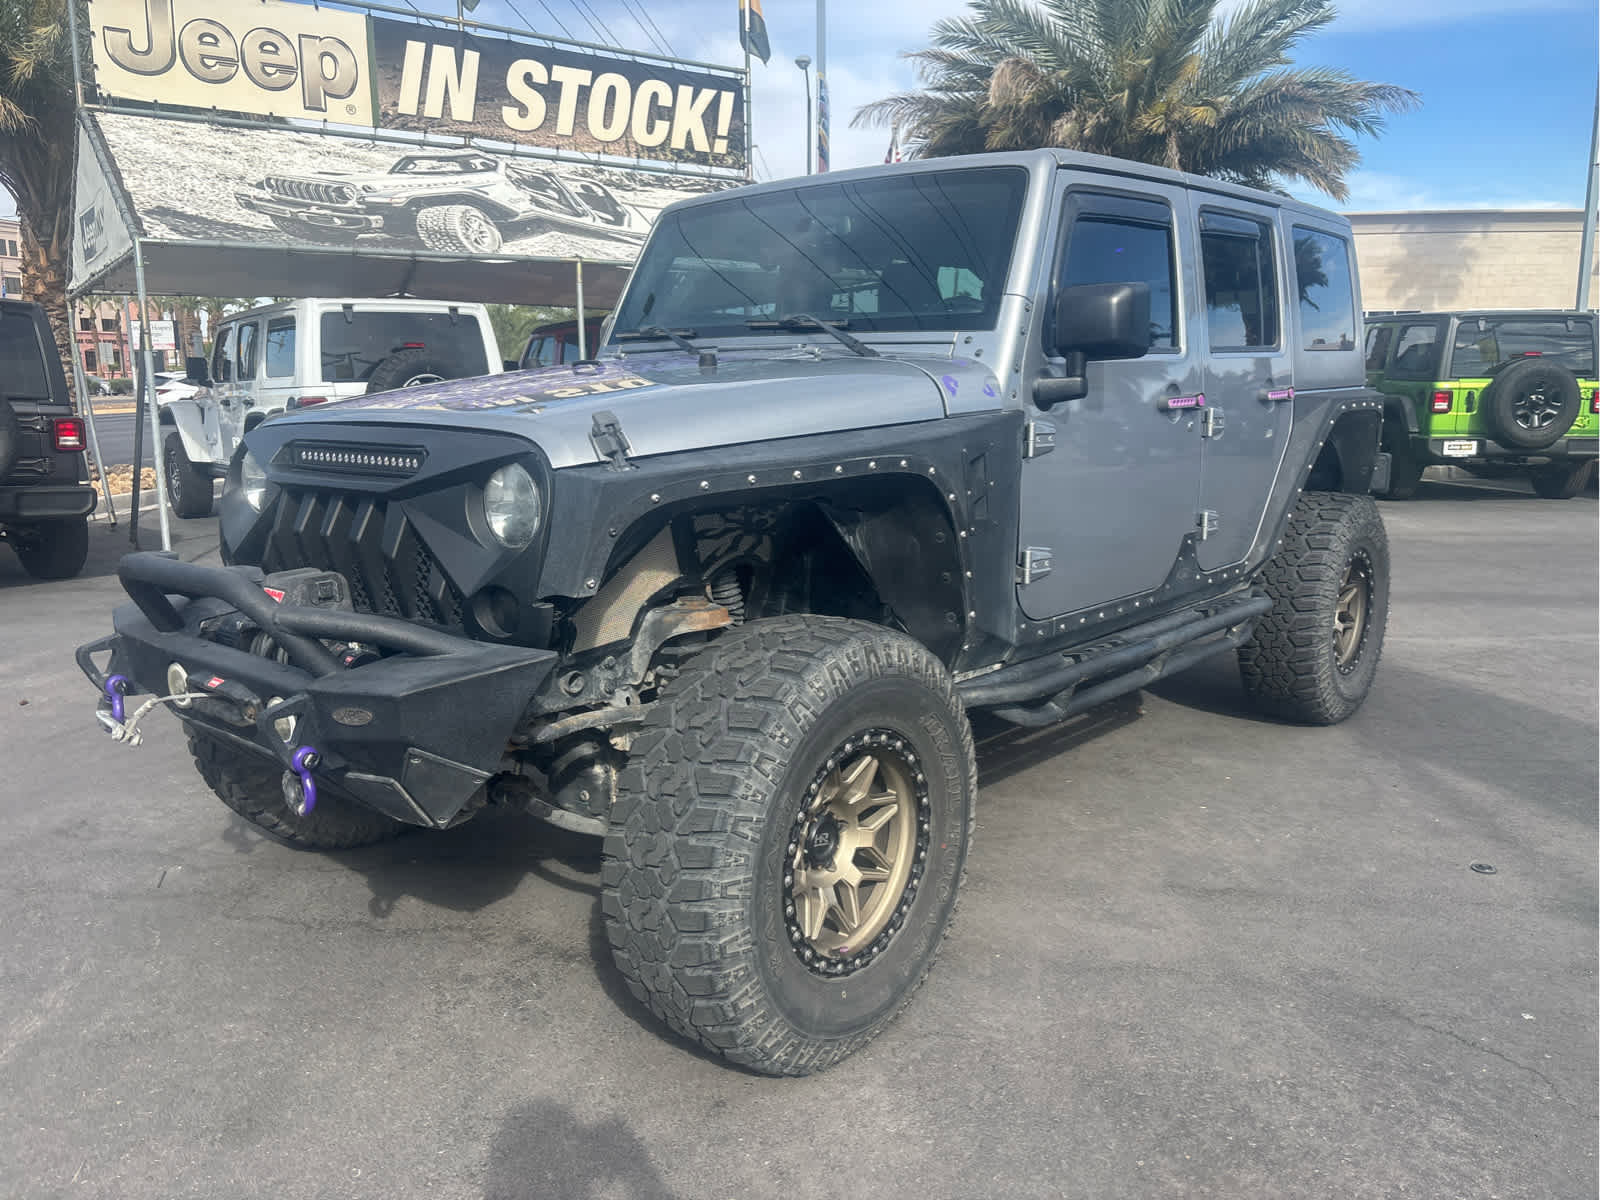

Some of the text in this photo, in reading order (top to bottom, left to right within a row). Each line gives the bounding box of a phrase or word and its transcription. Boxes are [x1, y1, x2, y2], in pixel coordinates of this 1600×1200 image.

[102, 0, 359, 112] Jeep
[397, 39, 736, 155] IN STOCK!
